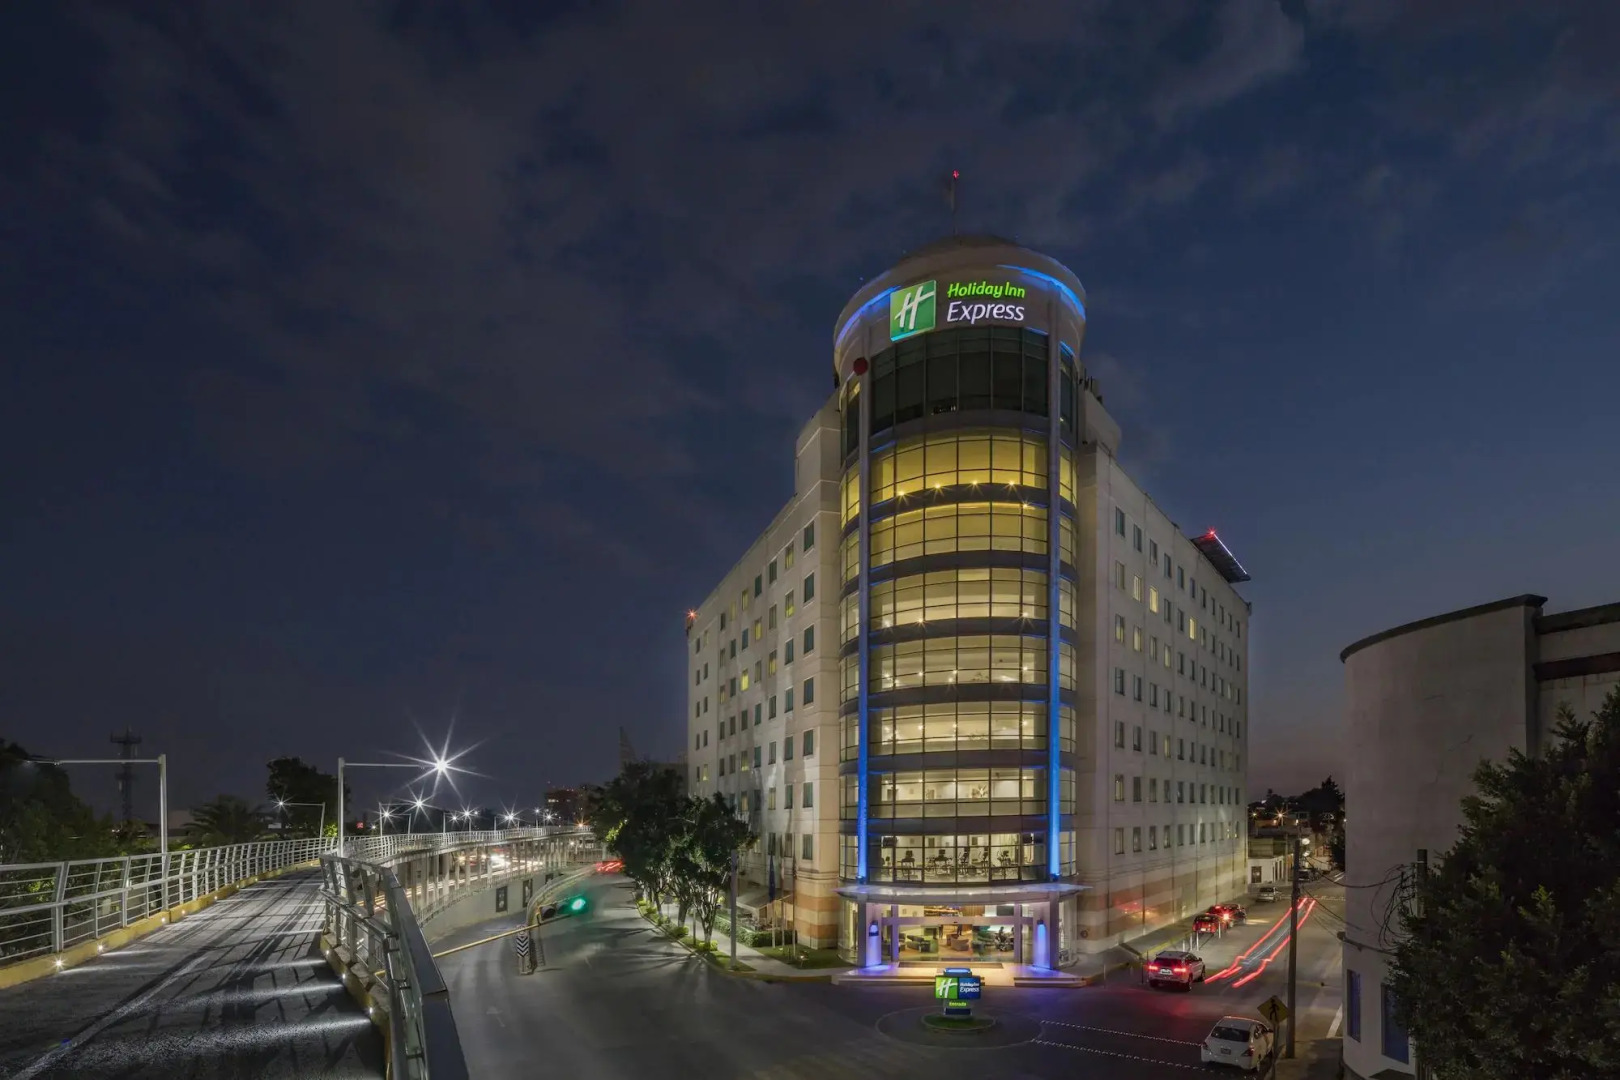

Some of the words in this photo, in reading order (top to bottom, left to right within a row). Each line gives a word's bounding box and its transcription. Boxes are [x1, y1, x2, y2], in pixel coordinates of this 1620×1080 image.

[947, 281, 1003, 298] Holiday
[1005, 281, 1026, 298] Inn
[946, 300, 1025, 325] Express
